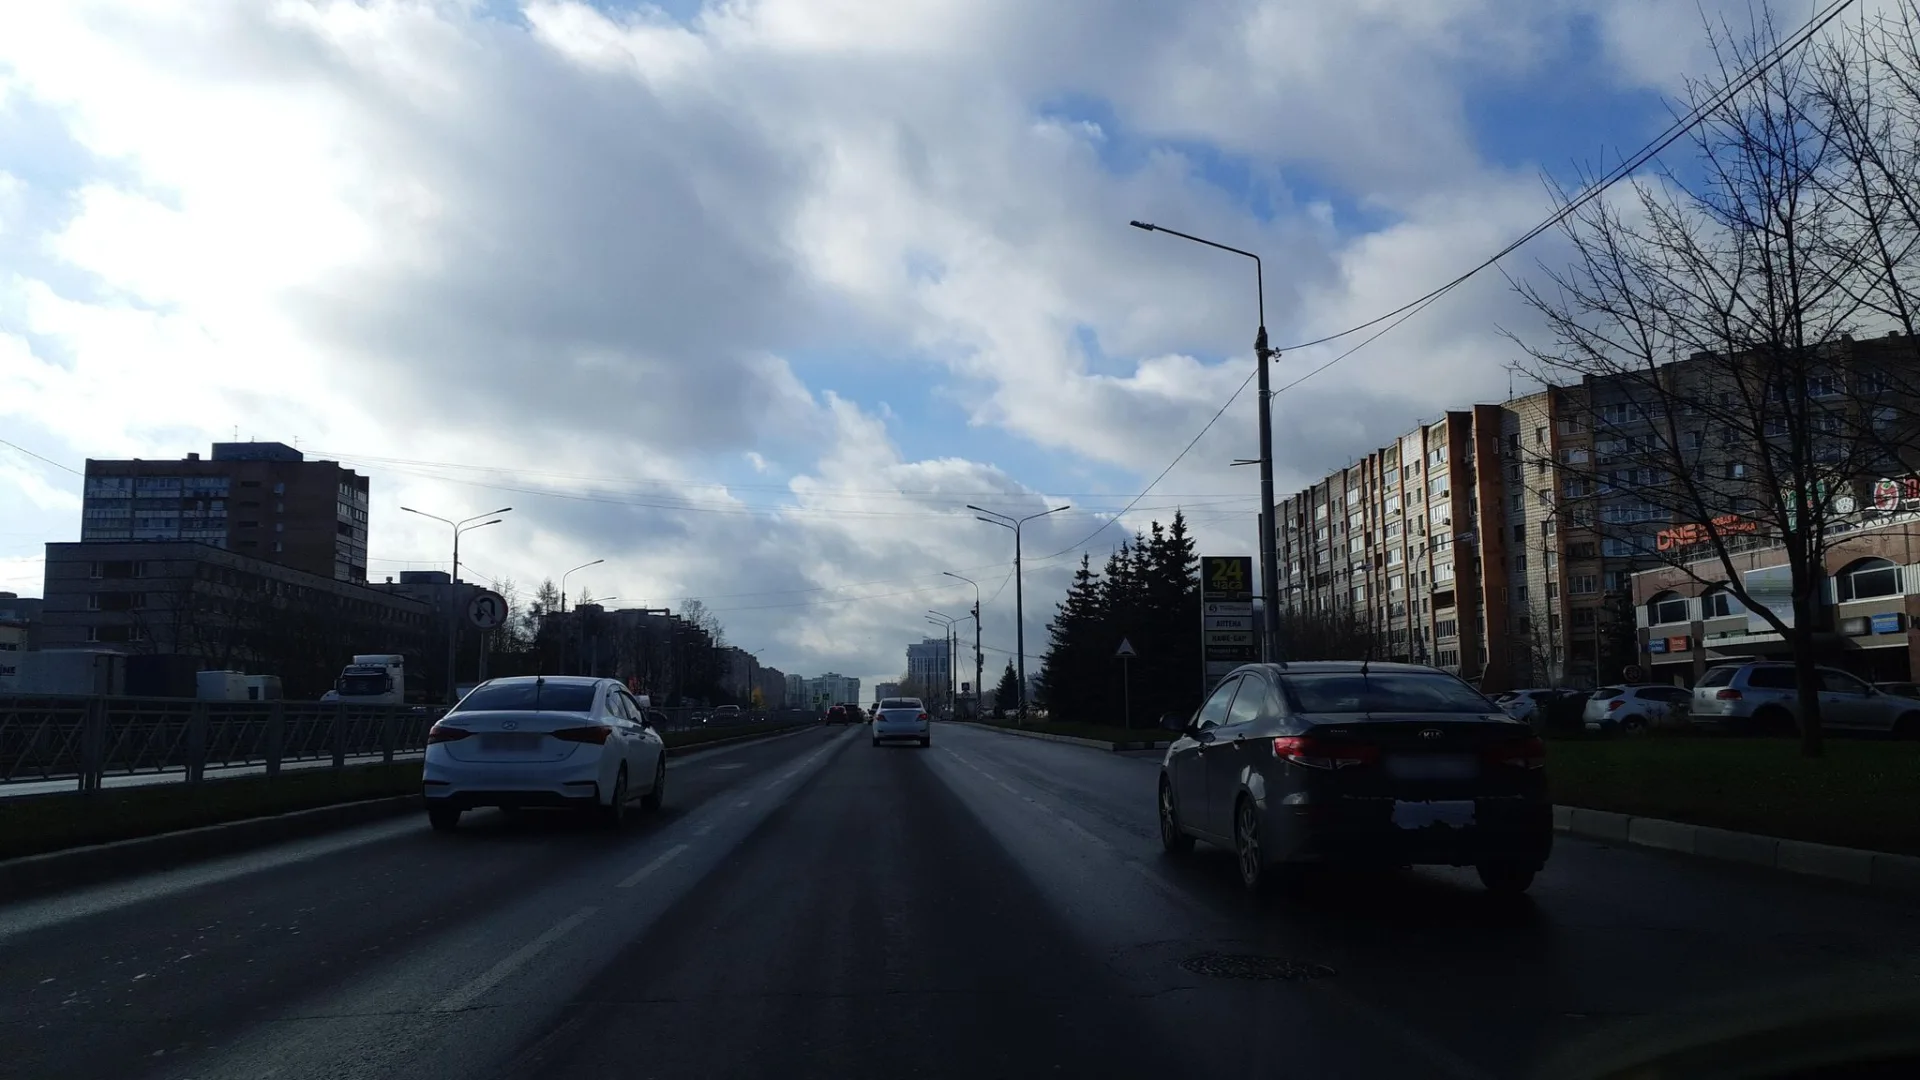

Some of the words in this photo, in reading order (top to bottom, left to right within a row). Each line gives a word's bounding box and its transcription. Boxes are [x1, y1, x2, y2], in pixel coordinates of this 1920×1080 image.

[1211, 559, 1243, 581] 24
[1212, 581, 1243, 590] часа
[1423, 731, 1442, 740] KIA
